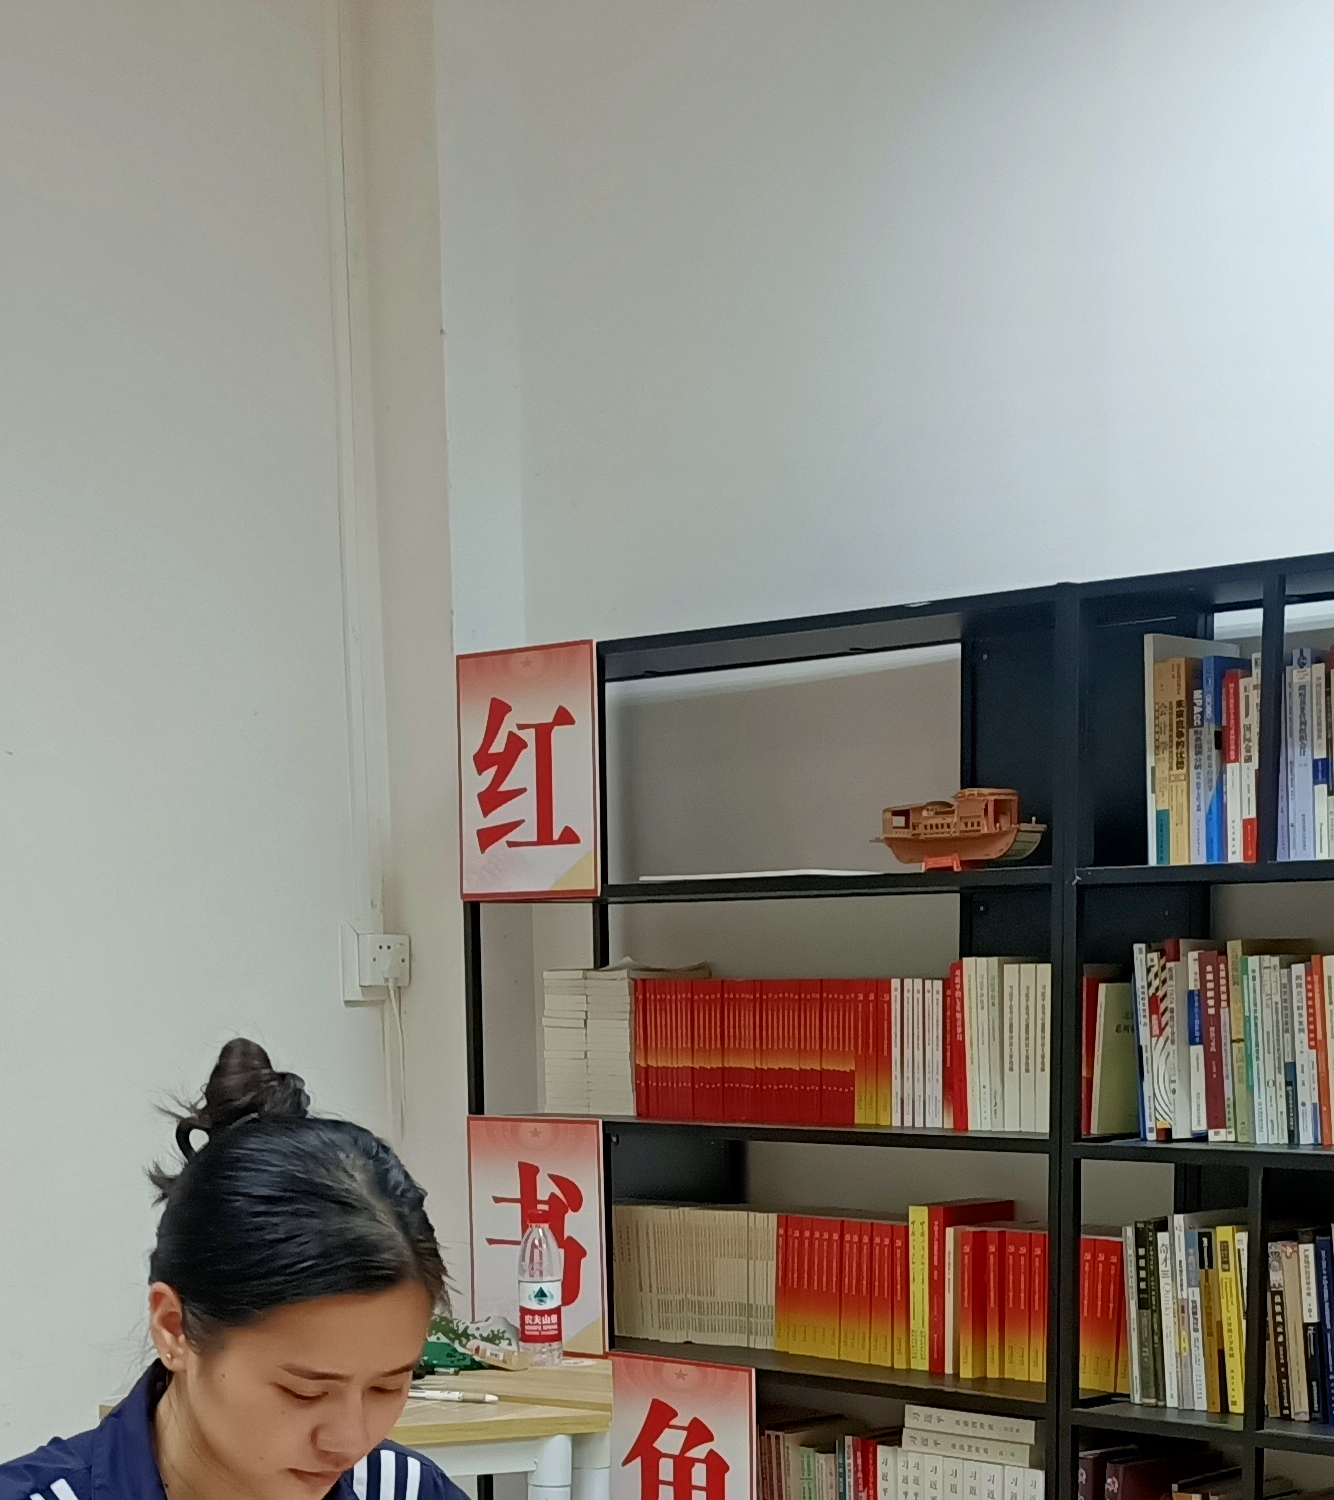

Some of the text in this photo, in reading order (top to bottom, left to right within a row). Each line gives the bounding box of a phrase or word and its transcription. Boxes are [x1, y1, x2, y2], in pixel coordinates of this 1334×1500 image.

[471, 697, 581, 856] 红
[485, 1161, 587, 1307] 书
[908, 1434, 942, 1448] 习近平
[911, 1411, 946, 1425] 习近平
